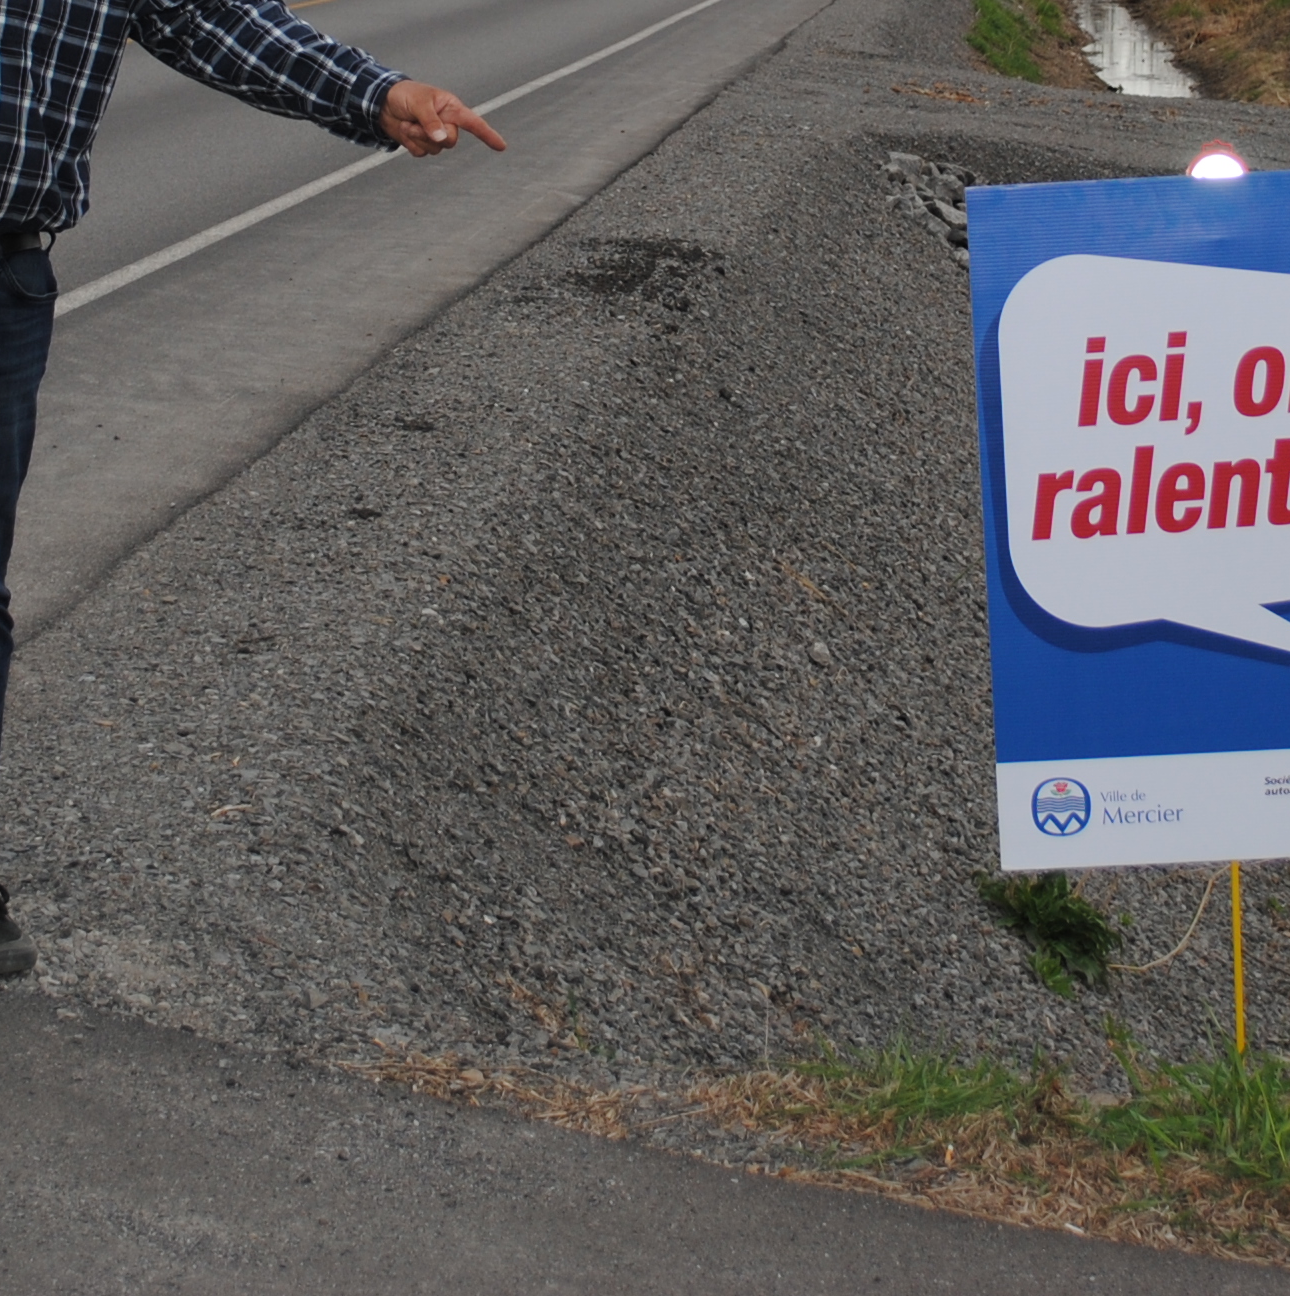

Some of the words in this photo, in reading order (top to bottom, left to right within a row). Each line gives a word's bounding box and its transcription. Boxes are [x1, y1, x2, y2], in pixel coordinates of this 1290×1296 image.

[1078, 331, 1203, 435] ici,
[1100, 790, 1127, 803] Ville
[1130, 788, 1146, 802] de
[1102, 804, 1184, 825] Mercier
